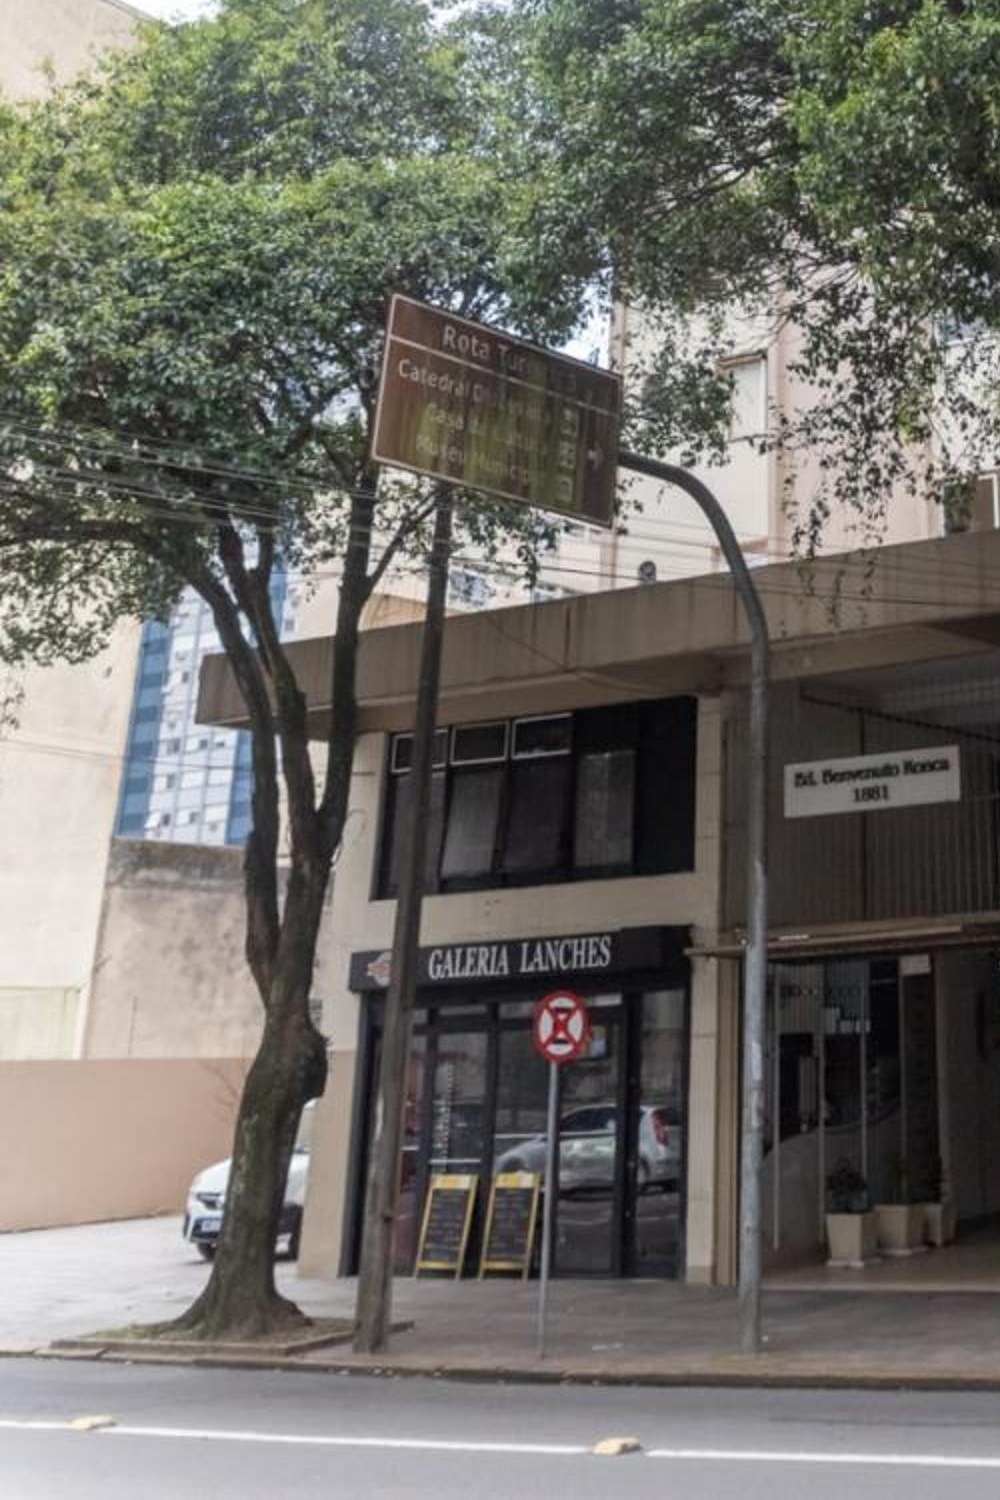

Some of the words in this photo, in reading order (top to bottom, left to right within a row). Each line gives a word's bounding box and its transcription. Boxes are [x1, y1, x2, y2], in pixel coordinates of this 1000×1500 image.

[443, 325, 490, 360] Rota
[398, 359, 473, 399] Catedral
[428, 945, 509, 980] GALERIA
[519, 935, 612, 973] LANCHES
